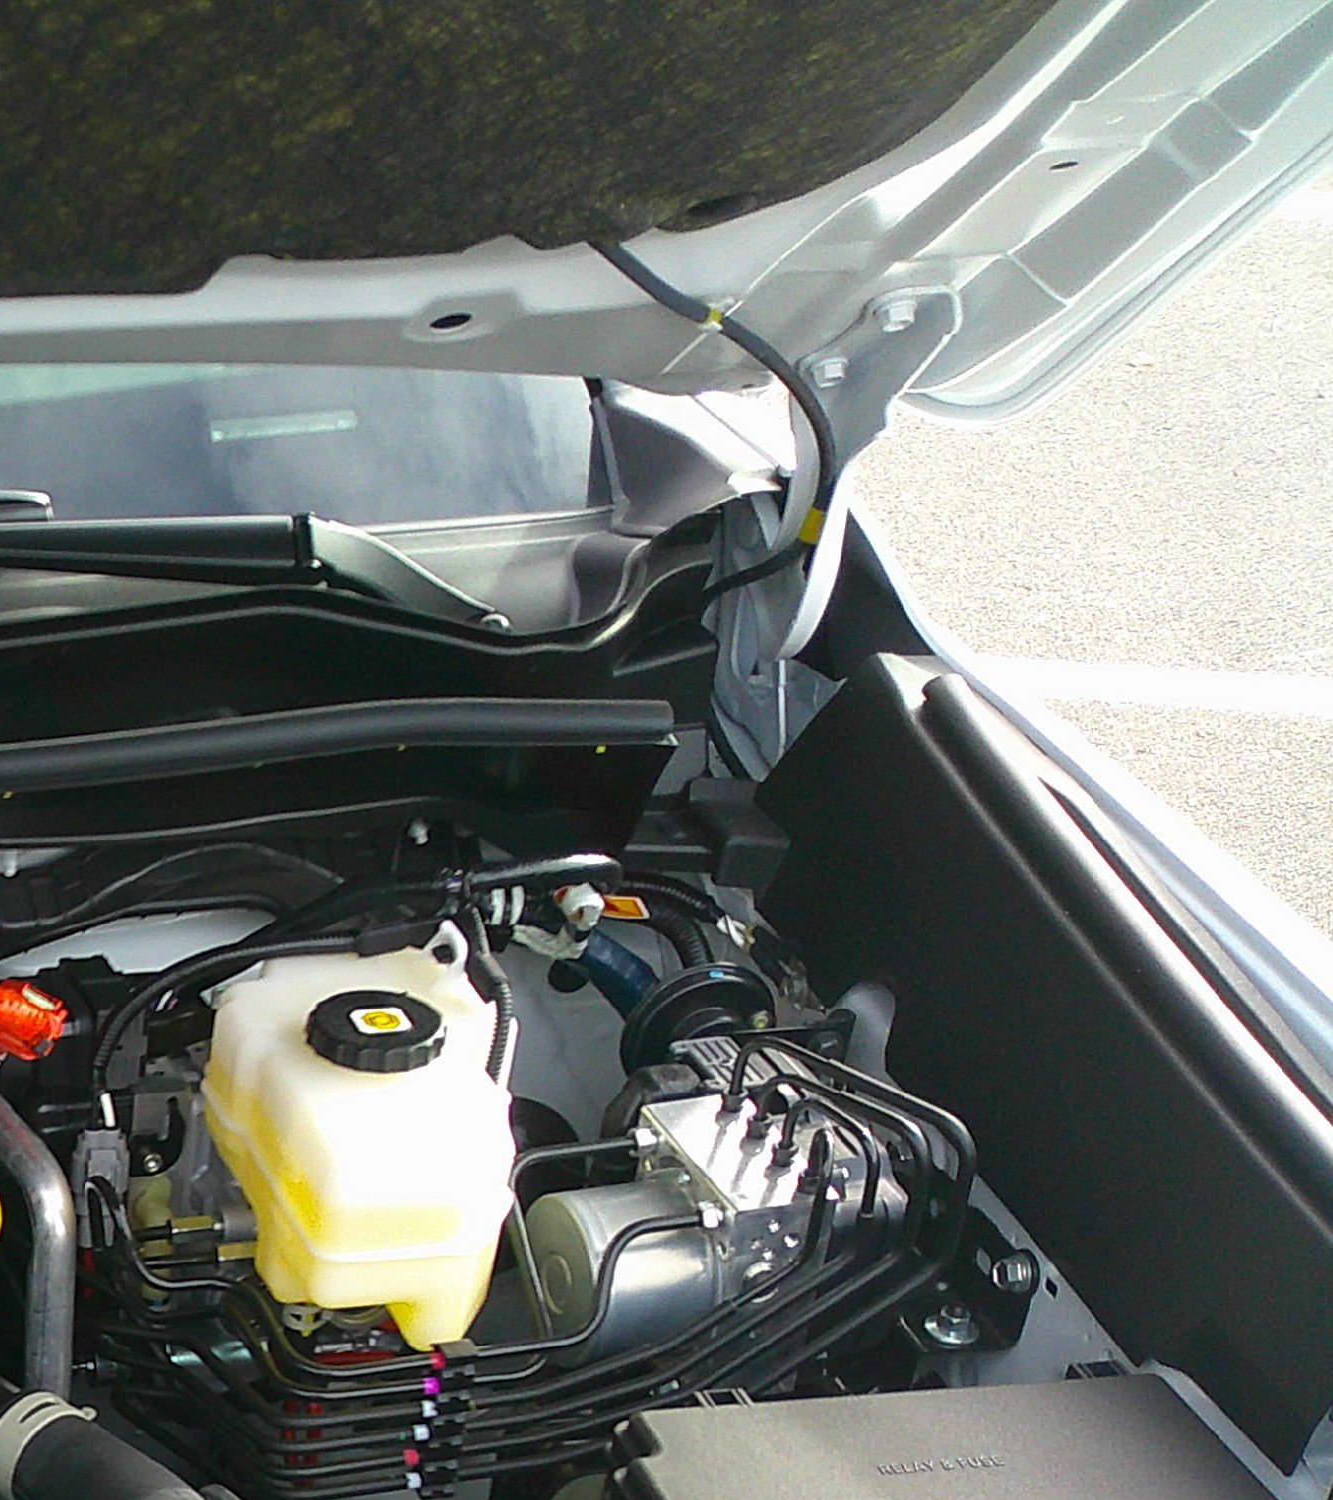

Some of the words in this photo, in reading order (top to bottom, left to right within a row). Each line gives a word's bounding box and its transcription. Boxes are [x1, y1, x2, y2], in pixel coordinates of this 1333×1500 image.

[876, 1459, 934, 1476] RELAY
[939, 1458, 954, 1471] &
[955, 1453, 1005, 1470] FUSE
